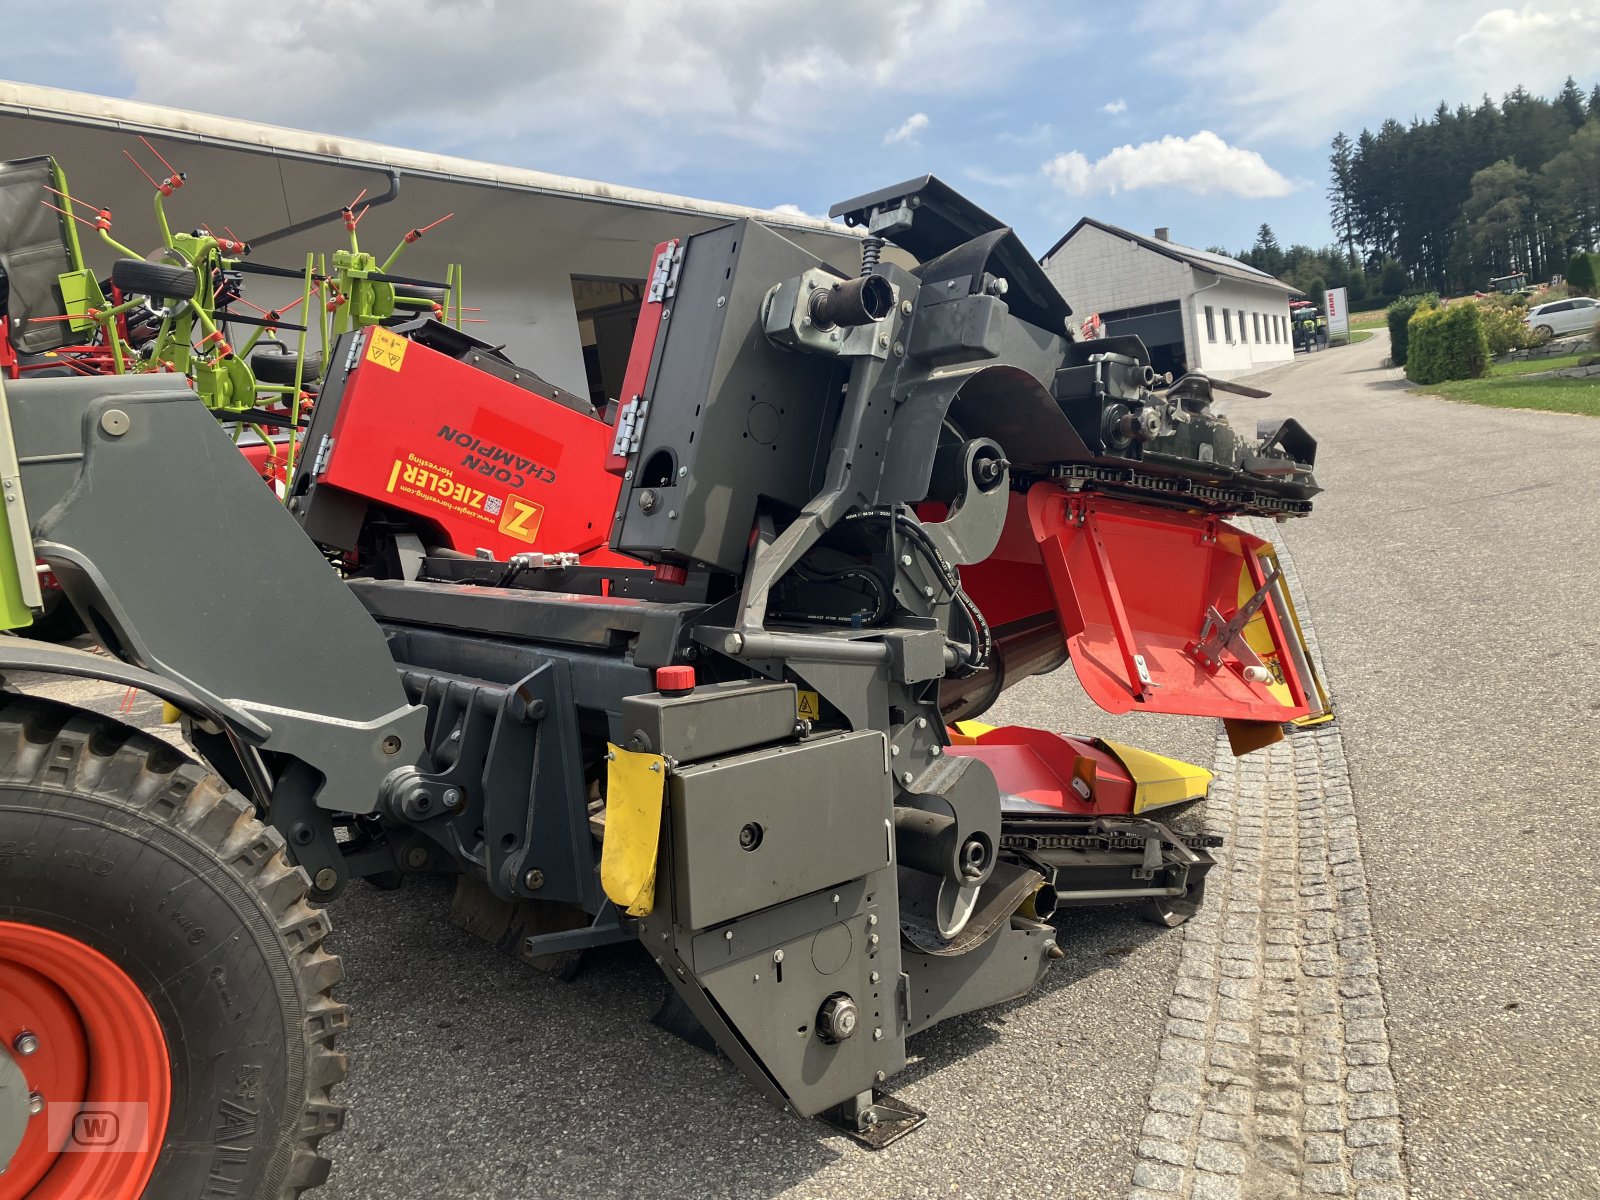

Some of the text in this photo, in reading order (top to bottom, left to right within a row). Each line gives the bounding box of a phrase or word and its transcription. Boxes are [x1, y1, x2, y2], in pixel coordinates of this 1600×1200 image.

[408, 453, 453, 477] Harvesting
[436, 425, 556, 484] CHAMPION
[461, 454, 525, 488] CORN
[400, 484, 496, 524] www.ziegler-harvesting.com
[403, 463, 486, 509] ZIEGLER
[506, 501, 537, 536] Z
